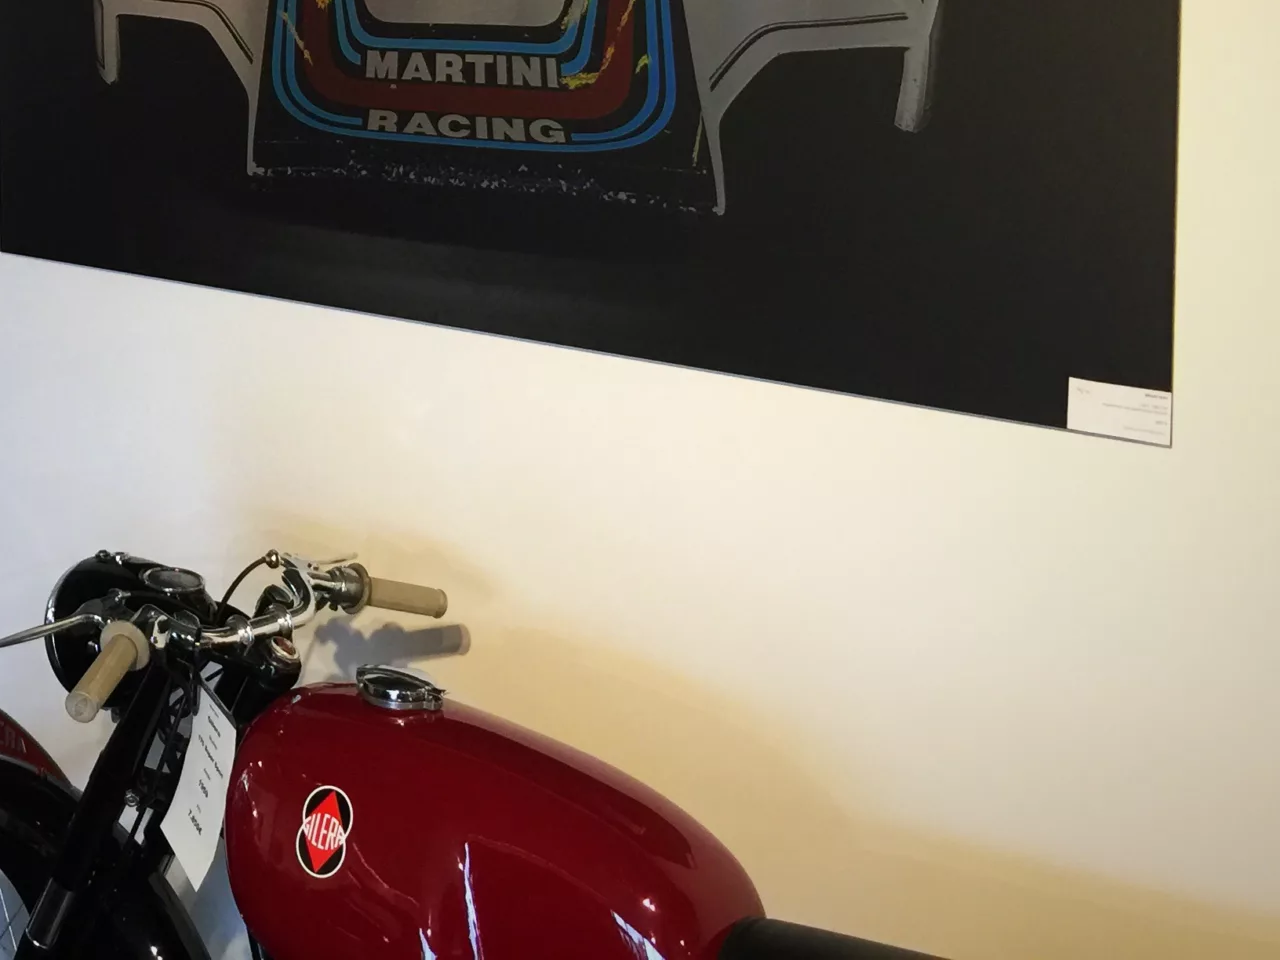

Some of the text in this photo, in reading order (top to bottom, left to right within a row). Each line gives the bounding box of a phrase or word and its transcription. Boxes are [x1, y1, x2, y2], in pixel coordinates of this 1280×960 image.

[365, 48, 561, 89] MARTINI
[366, 108, 567, 144] RACING
[302, 812, 347, 851] GILERA
